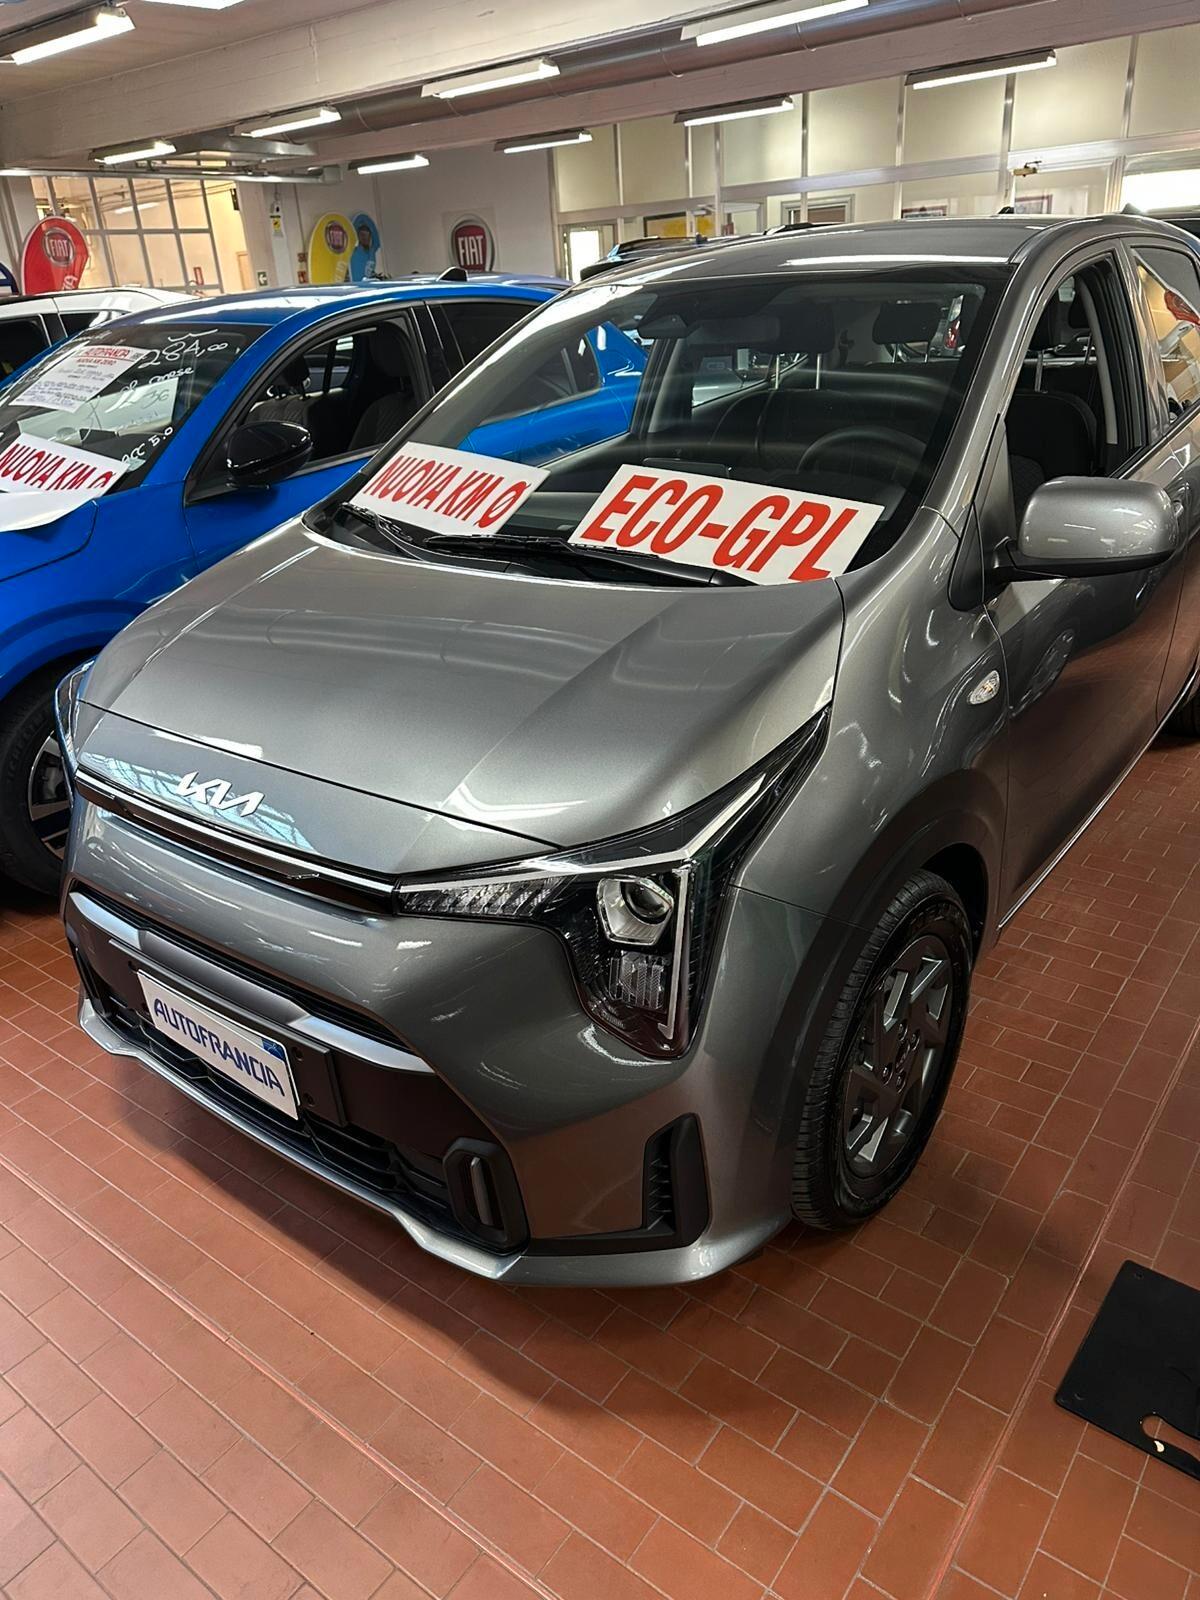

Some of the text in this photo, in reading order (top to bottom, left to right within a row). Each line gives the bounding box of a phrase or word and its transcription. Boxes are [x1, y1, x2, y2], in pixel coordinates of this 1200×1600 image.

[49, 239, 69, 257] FIAT
[458, 235, 484, 266] FIAT
[0, 444, 66, 488] NUOVA
[46, 461, 98, 490] KM
[363, 455, 463, 509] NUOVA
[434, 470, 505, 521] KM
[580, 474, 860, 583] ECO-GPL
[175, 771, 266, 817] KIA
[154, 997, 286, 1097] AUTOFRANCIA
